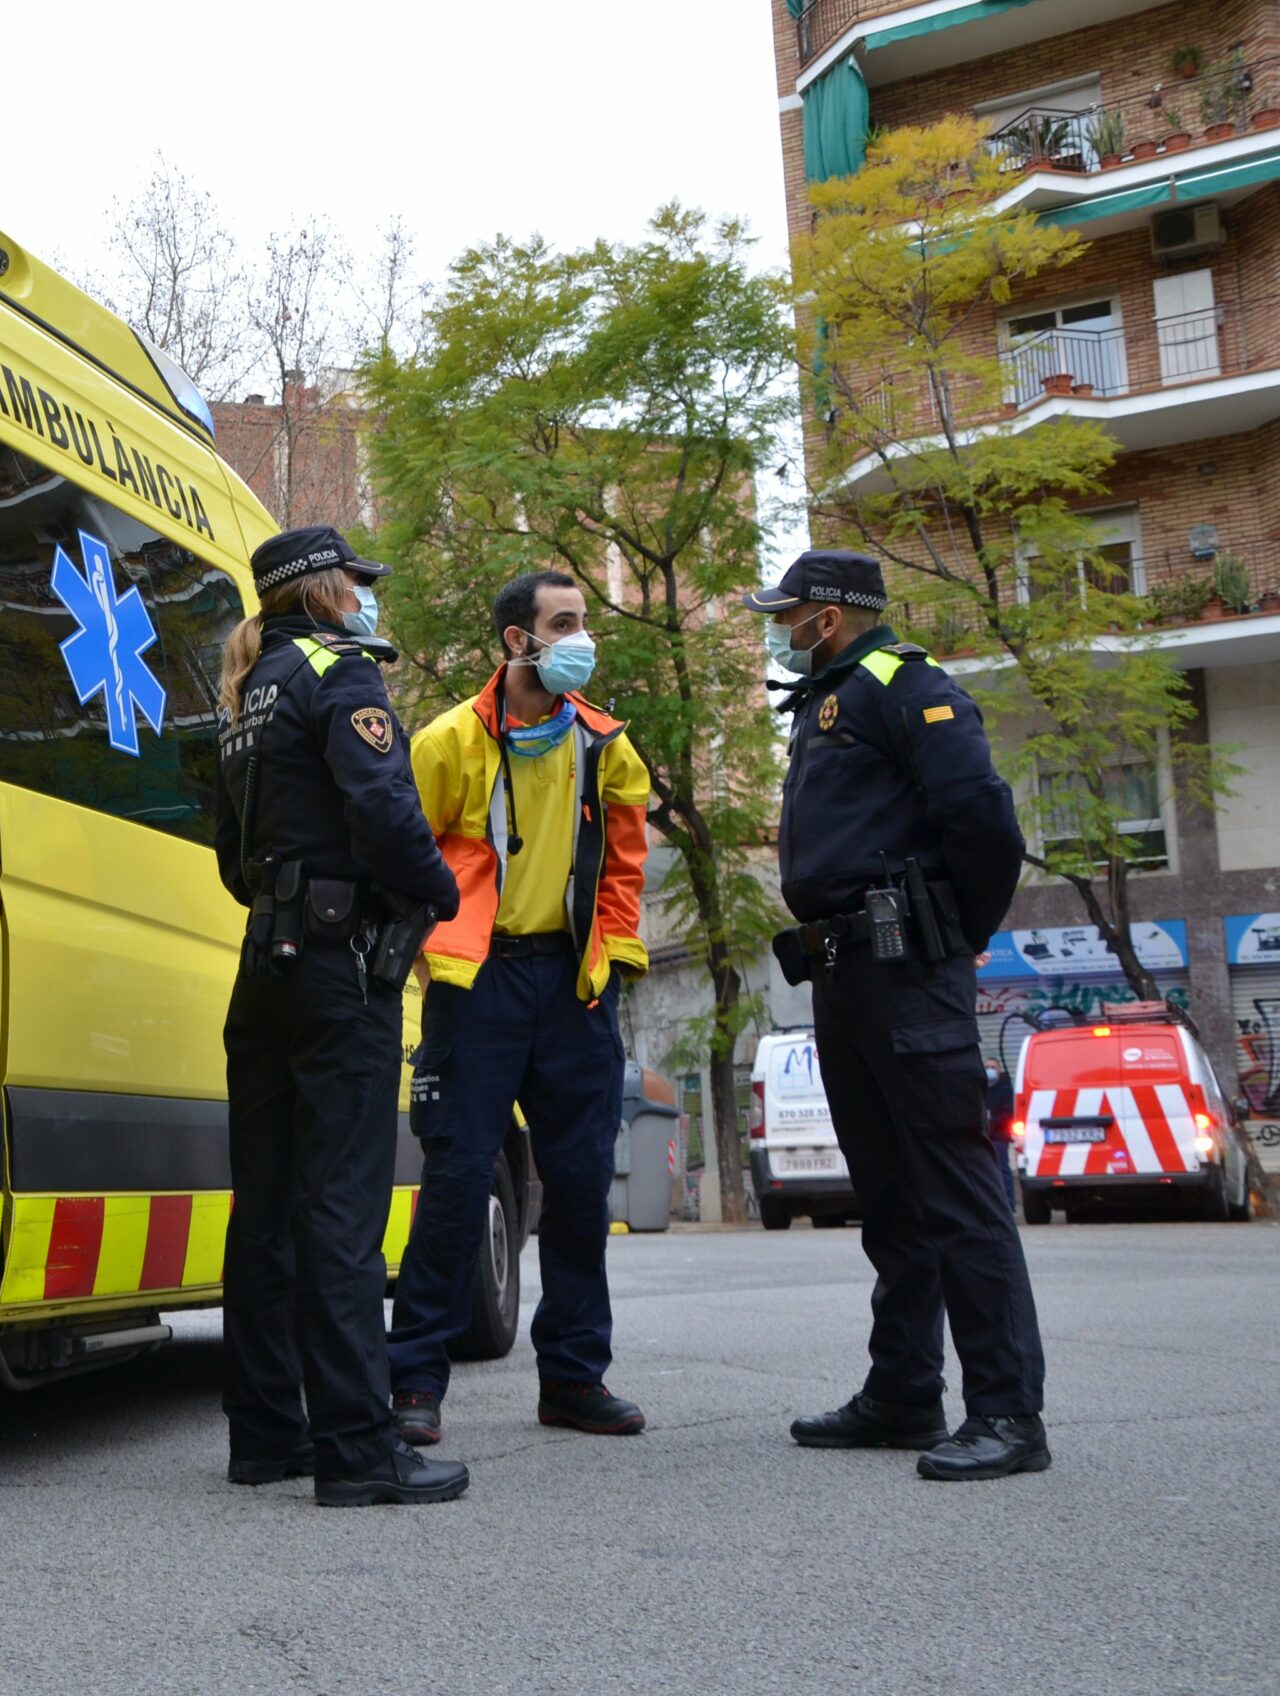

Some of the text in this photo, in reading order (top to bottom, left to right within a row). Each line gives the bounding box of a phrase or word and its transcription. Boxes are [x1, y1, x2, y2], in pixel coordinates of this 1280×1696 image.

[308, 549, 338, 563] POLICIA
[810, 586, 841, 597] POLICIA
[244, 711, 273, 729] urbaa
